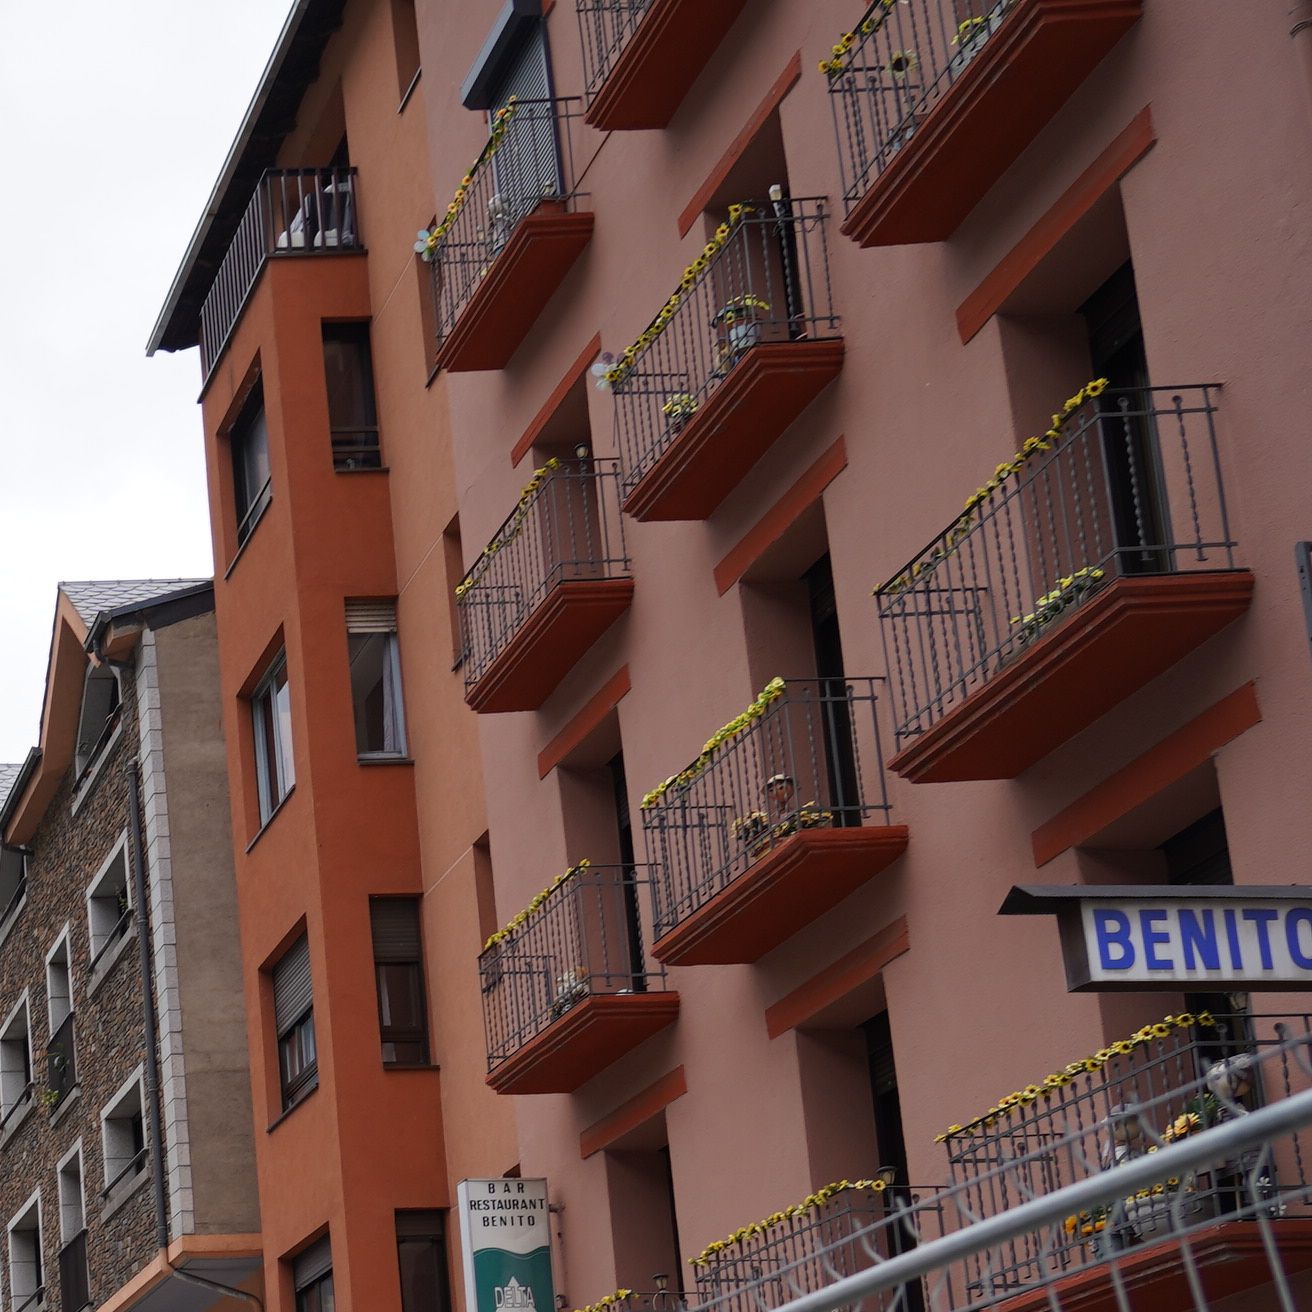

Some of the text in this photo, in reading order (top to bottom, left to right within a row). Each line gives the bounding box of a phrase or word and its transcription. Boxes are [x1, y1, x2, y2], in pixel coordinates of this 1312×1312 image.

[1092, 907, 1312, 971] BENITO
[487, 1182, 525, 1194] BAR
[469, 1198, 545, 1211] RESTAURANT
[482, 1214, 536, 1227] BENITO
[494, 1285, 536, 1309] DELTA
